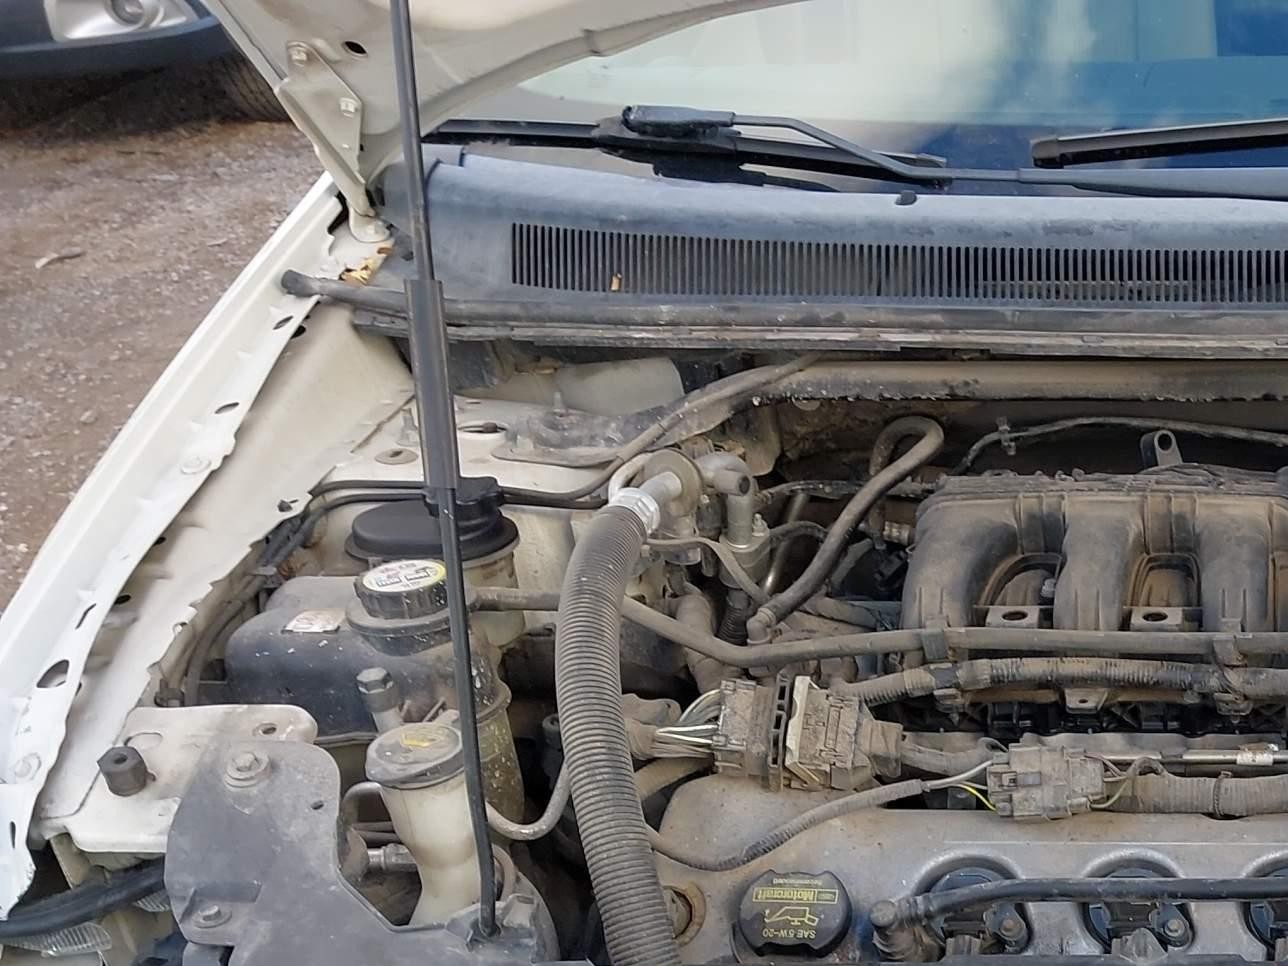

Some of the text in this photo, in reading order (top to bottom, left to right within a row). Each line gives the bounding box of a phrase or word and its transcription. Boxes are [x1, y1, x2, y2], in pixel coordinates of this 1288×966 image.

[757, 889, 815, 901] Motorcraft
[762, 928, 816, 939] SAE 5W-20
